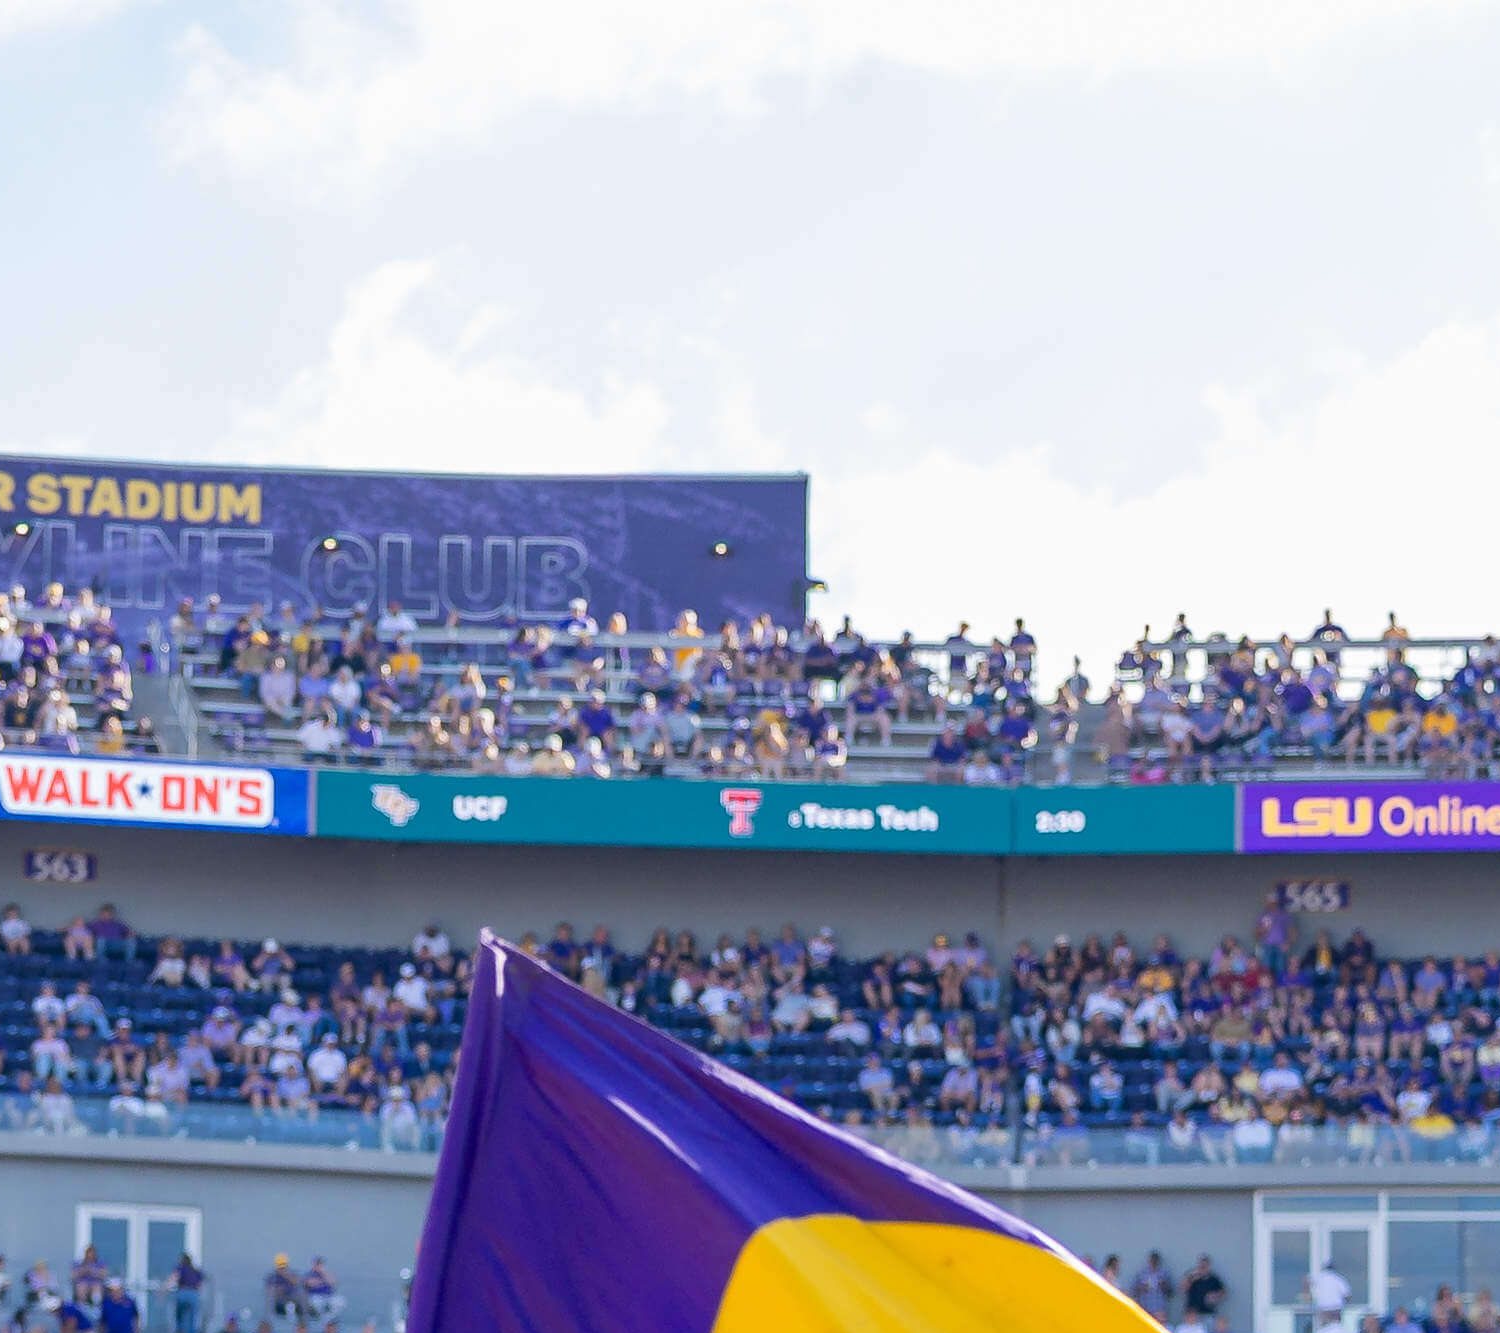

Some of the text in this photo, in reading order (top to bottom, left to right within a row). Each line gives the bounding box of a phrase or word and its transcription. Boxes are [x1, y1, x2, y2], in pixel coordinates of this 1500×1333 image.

[27, 474, 263, 524] STADIUM
[300, 533, 593, 622] CLUB
[453, 795, 509, 823] UCF
[877, 804, 939, 832] Tech
[1260, 797, 1374, 837] LSU
[30, 854, 89, 882] 563
[1284, 882, 1339, 912] 565
